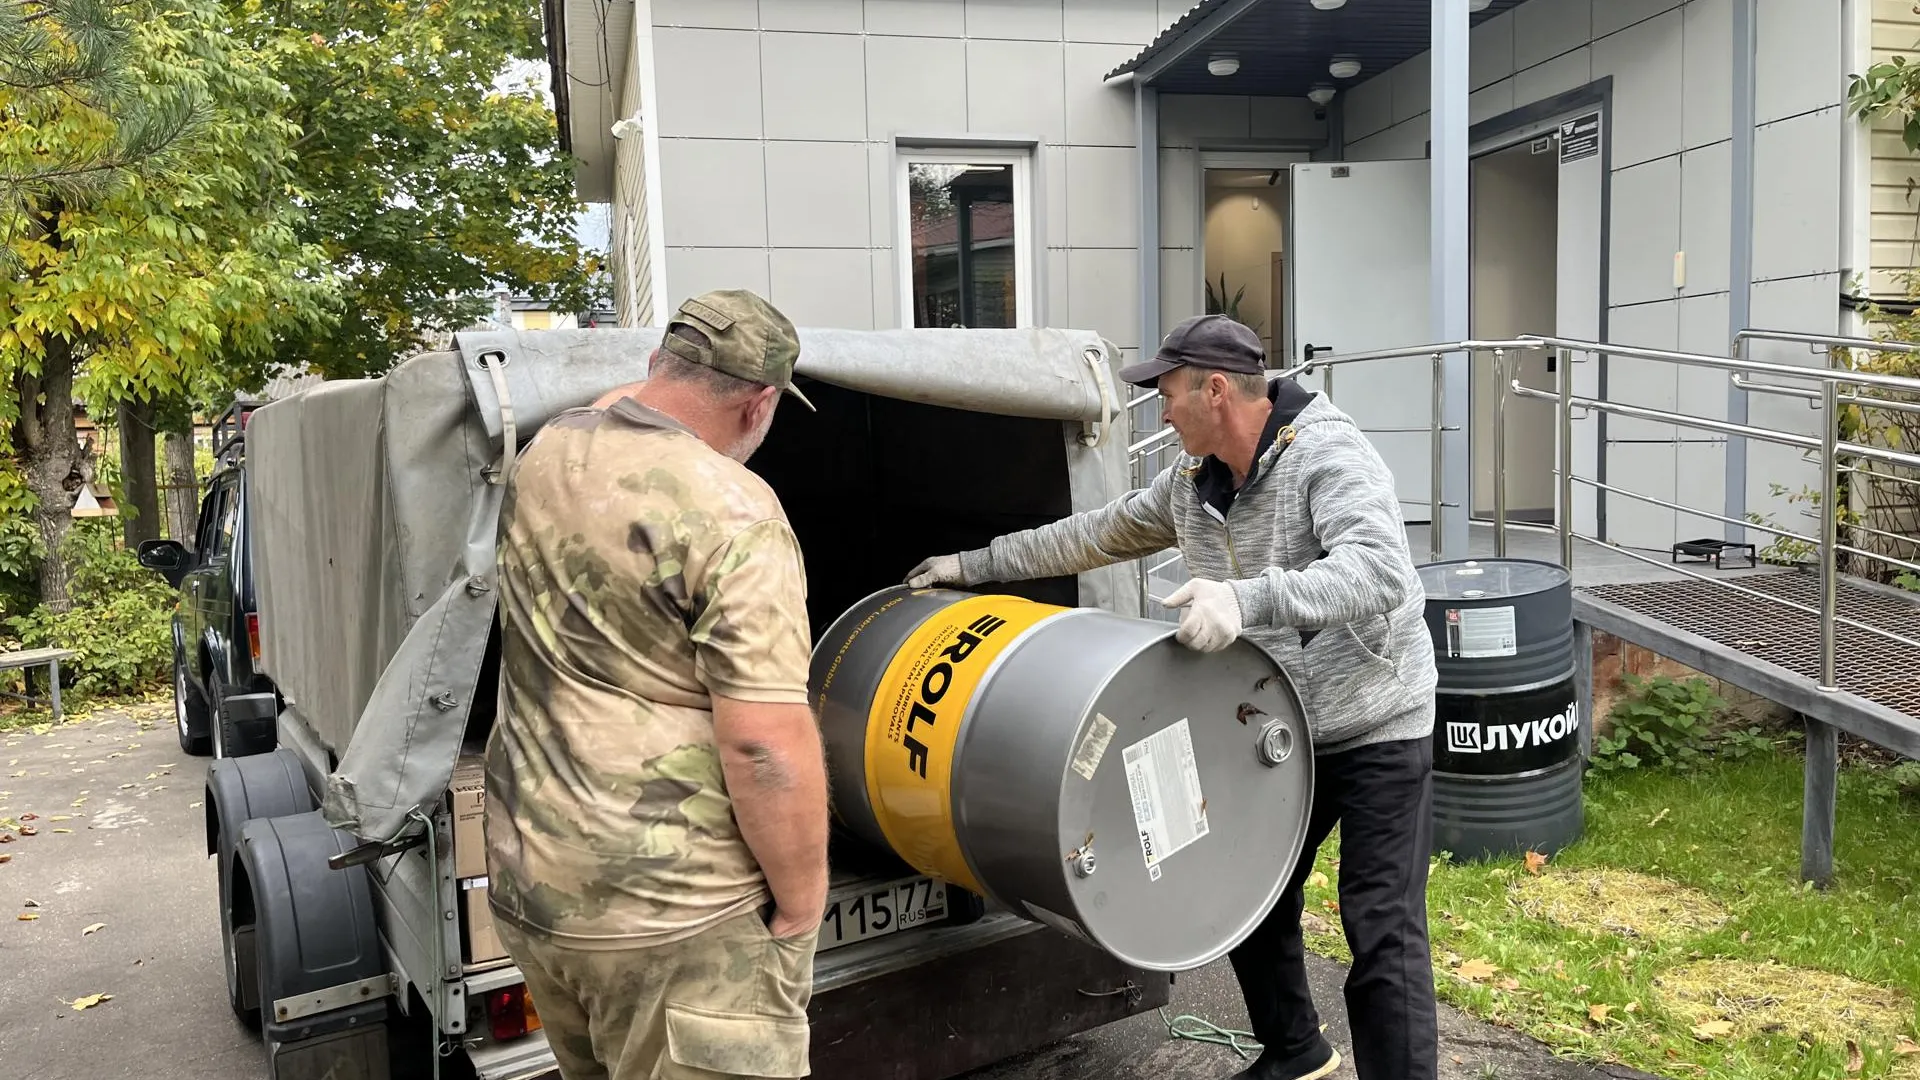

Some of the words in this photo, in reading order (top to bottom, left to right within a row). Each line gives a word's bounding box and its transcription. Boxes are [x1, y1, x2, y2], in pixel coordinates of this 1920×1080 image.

[840, 611, 880, 654] Lubricants
[919, 624, 953, 659] ORIGINAL
[907, 660, 921, 680] OEM
[913, 626, 958, 681] PROFESSIONAL
[888, 681, 908, 740] APPROVALS
[894, 683, 916, 743] LUBRICANTS
[1141, 830, 1153, 857] ROLF
[900, 880, 933, 913] 77
[899, 910, 926, 925] RUS
